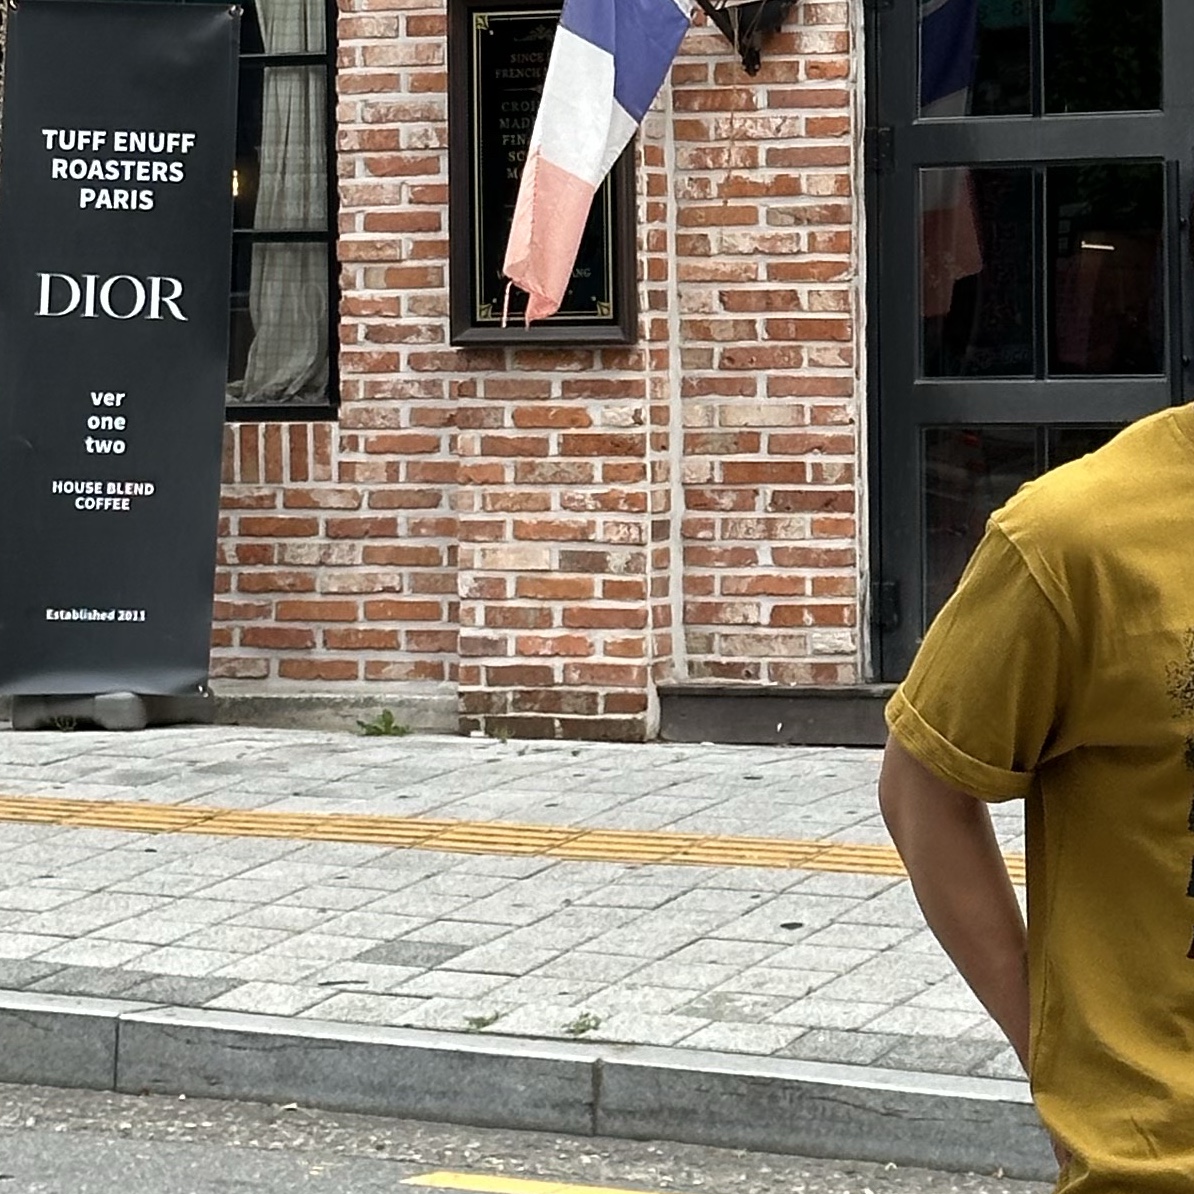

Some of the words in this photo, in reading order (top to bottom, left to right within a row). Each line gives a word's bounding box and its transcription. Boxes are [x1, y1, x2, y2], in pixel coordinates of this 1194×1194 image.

[495, 67, 542, 79] FRENCH
[41, 129, 107, 151] TUFF
[113, 131, 196, 154] ENUFF
[51, 158, 184, 183] ROASTERS
[79, 187, 154, 210] PARIS
[35, 273, 188, 321] DIOR
[90, 391, 126, 407] ver
[87, 415, 126, 431] one
[84, 437, 126, 454] two
[52, 480, 103, 495] HOUSE
[106, 481, 155, 496] BLEND
[74, 496, 130, 511] COFFEE
[46, 608, 116, 621] Established
[117, 610, 146, 622] 2011
